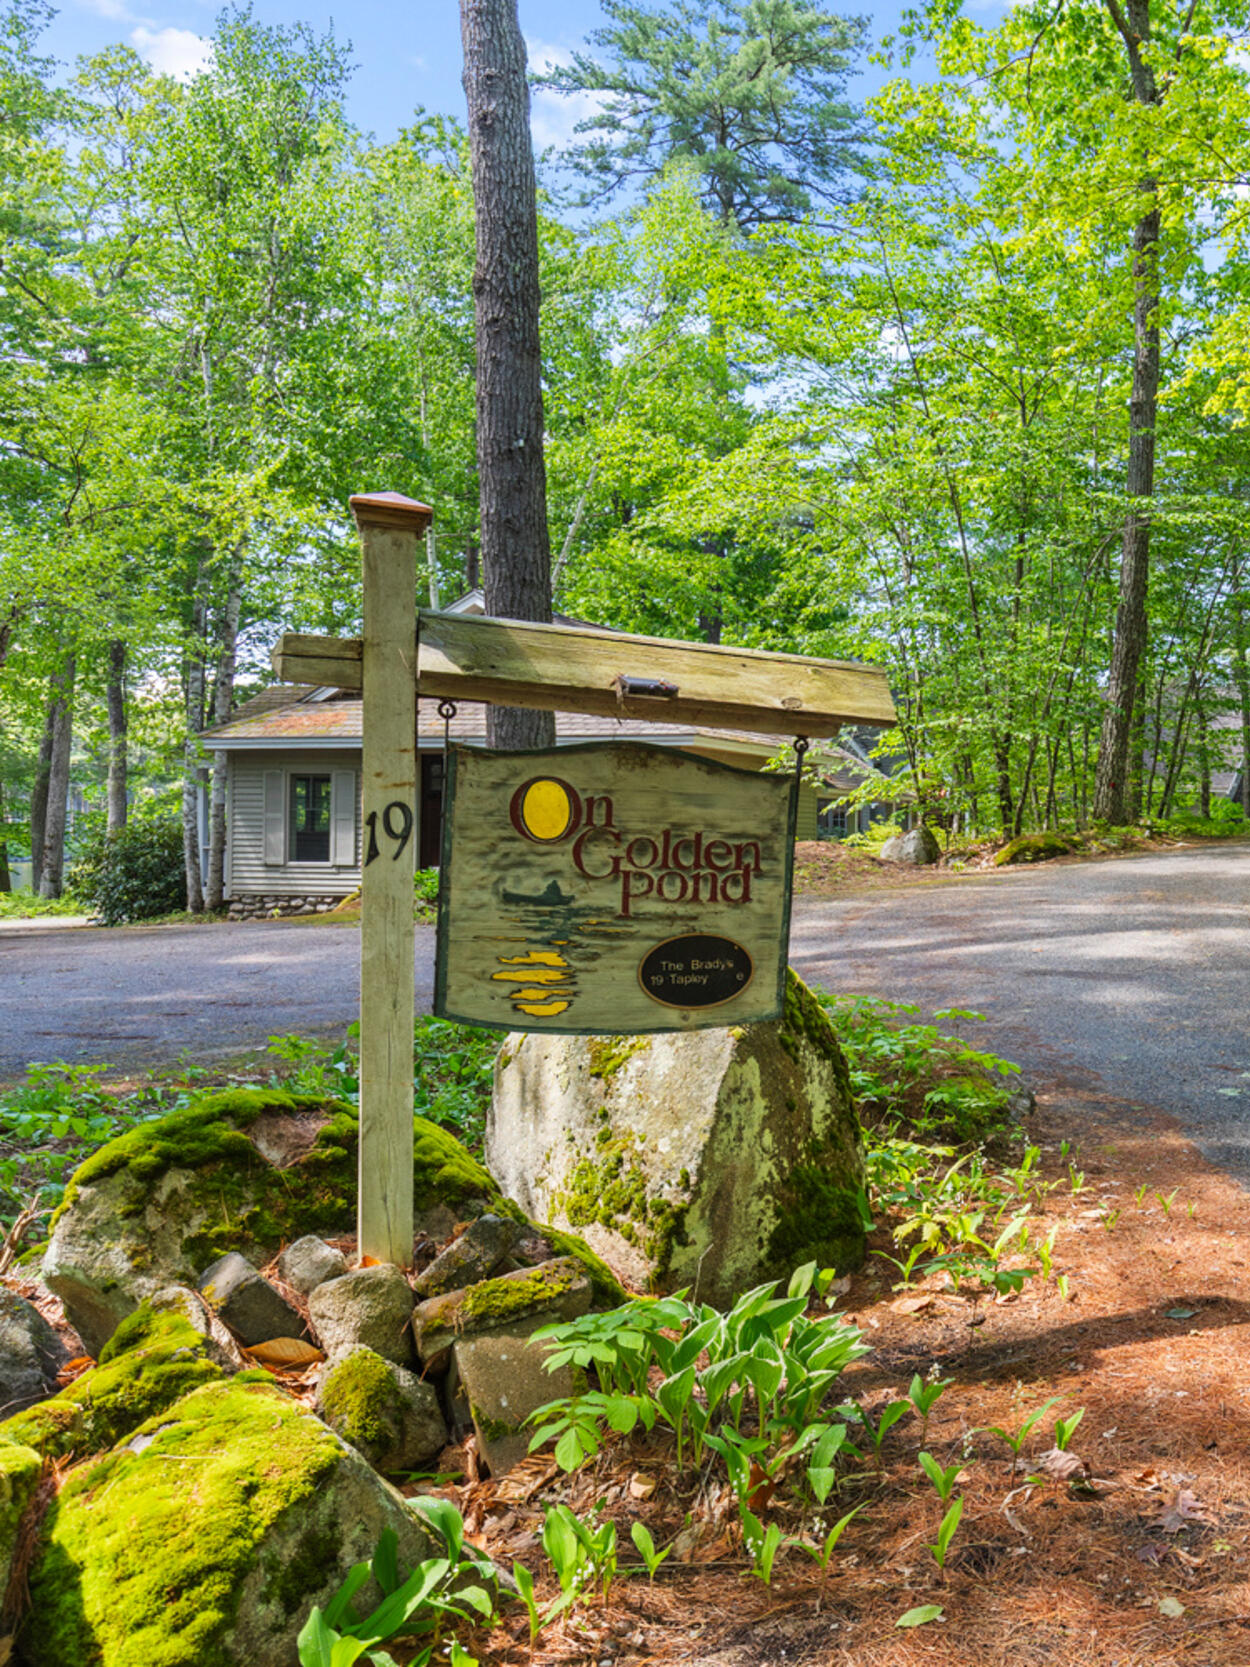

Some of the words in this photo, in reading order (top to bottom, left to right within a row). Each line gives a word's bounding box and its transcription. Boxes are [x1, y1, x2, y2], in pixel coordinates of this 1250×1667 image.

[364, 801, 412, 867] 19
[509, 775, 615, 845] On
[573, 828, 762, 879] Golden
[651, 974, 664, 986] 19
[669, 972, 709, 986] Tapley
[661, 961, 684, 971] The
